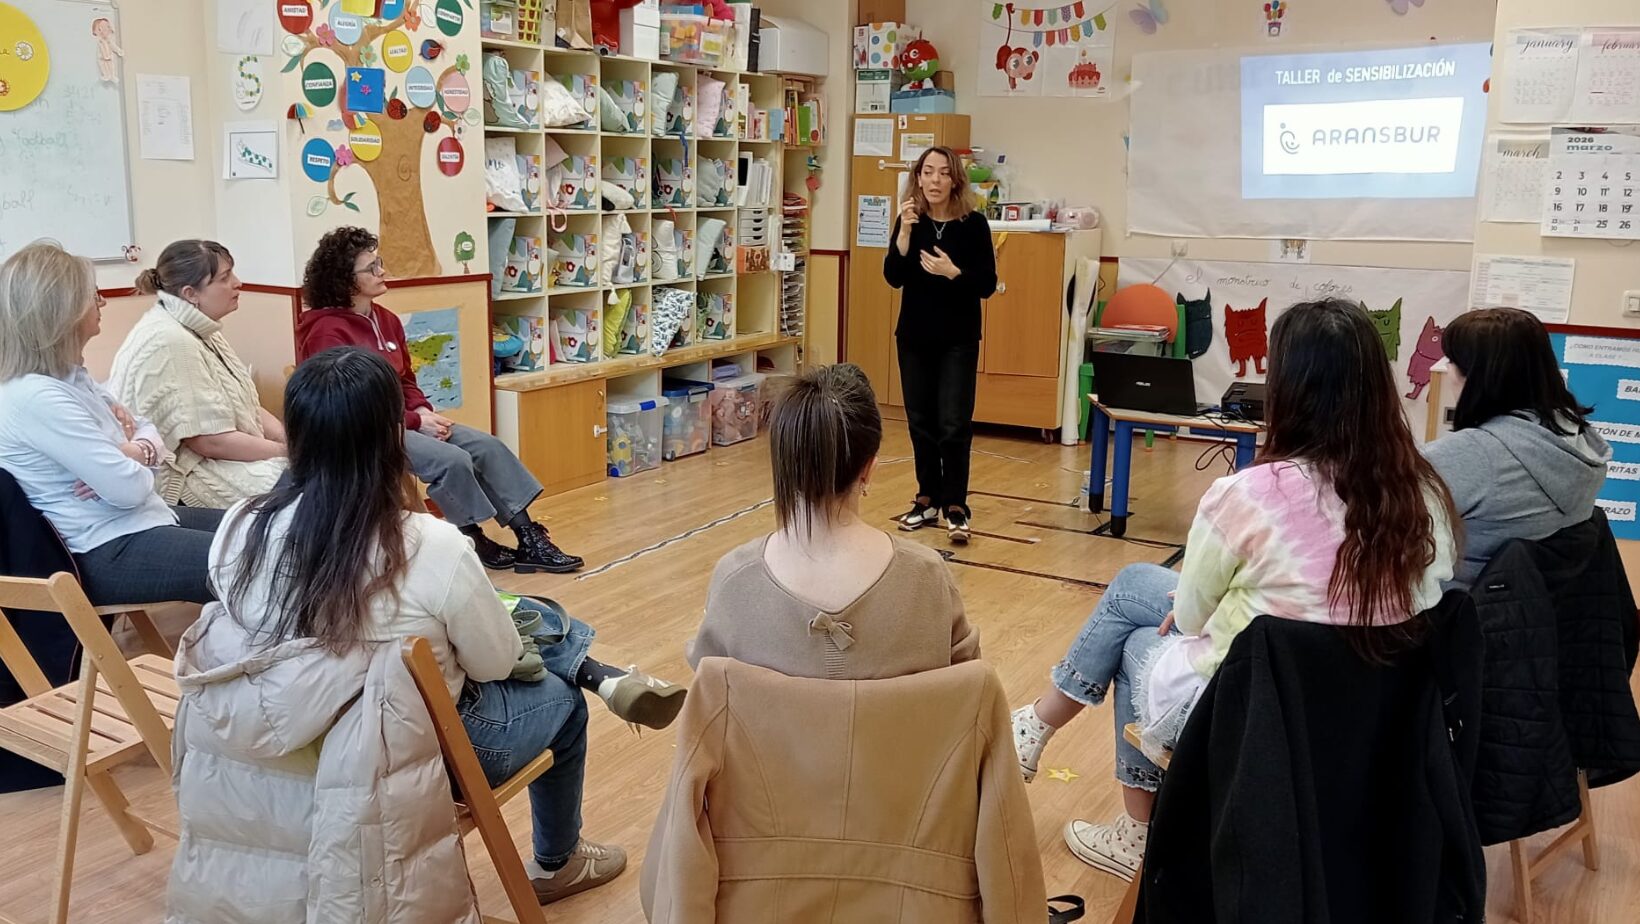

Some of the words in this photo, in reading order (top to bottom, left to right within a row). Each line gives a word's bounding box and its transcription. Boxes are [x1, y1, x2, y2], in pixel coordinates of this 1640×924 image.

[1521, 38, 1574, 54] january
[1275, 68, 1321, 85] TALLER
[1327, 68, 1343, 83] de
[1345, 58, 1456, 83] SENSIBILIZACIÓN
[350, 136, 380, 144] SOLIDARIDAD
[1312, 125, 1441, 146] ARANSBUR
[1502, 144, 1543, 159] march
[1556, 171, 1563, 180] 2
[1578, 171, 1585, 180] 3
[1601, 171, 1609, 180] 4
[1625, 172, 1631, 181] 5
[1554, 187, 1561, 196] 9
[1577, 187, 1587, 196] 10
[1623, 188, 1633, 197] 12
[1553, 203, 1563, 212] 16
[1576, 203, 1585, 212] 17
[1598, 204, 1608, 213] 18
[1596, 220, 1608, 228] 25
[1619, 220, 1631, 229] 26
[1185, 268, 1203, 284] el
[1289, 276, 1301, 290] de
[1624, 385, 1640, 394] BA
[1598, 427, 1616, 436] TÓN
[1619, 429, 1632, 438] DE
[1609, 465, 1638, 475] RITAS
